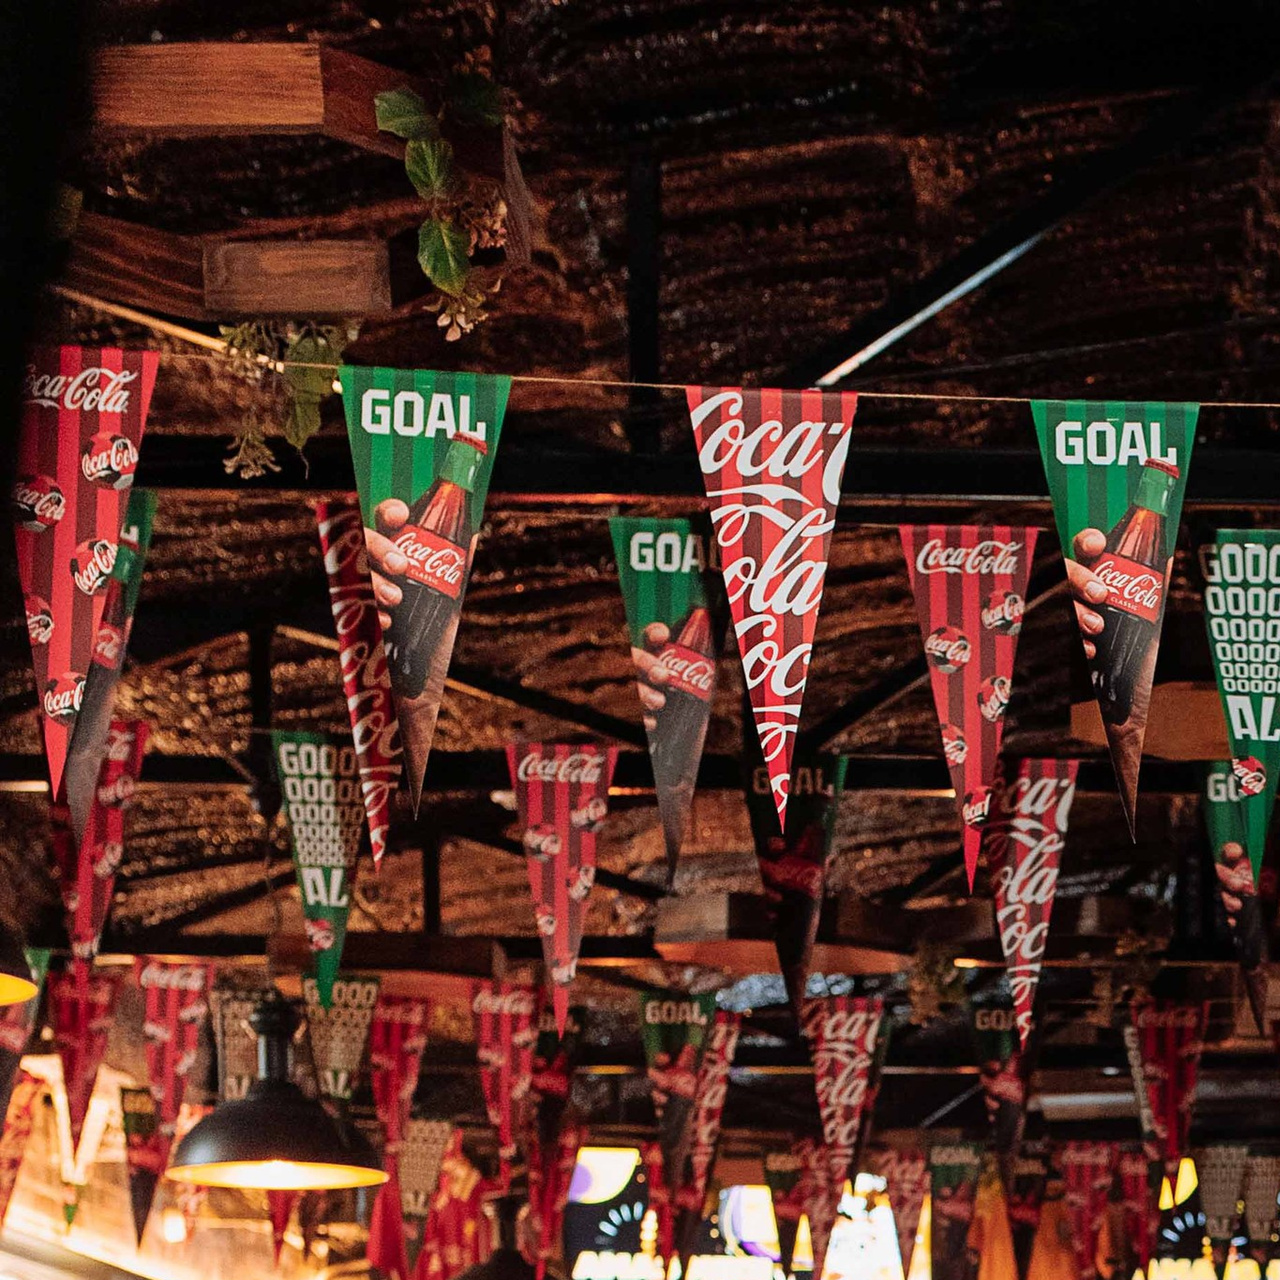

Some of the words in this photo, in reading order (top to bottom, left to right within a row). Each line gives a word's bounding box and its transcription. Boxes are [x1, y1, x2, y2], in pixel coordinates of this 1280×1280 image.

[361, 389, 487, 441] GOAL
[1055, 421, 1177, 466] GOAL
[916, 539, 1024, 575] Coca-Cola
[518, 753, 607, 783] Coca-Cola
[301, 867, 349, 907] AL
[645, 1001, 707, 1025] GOAL
